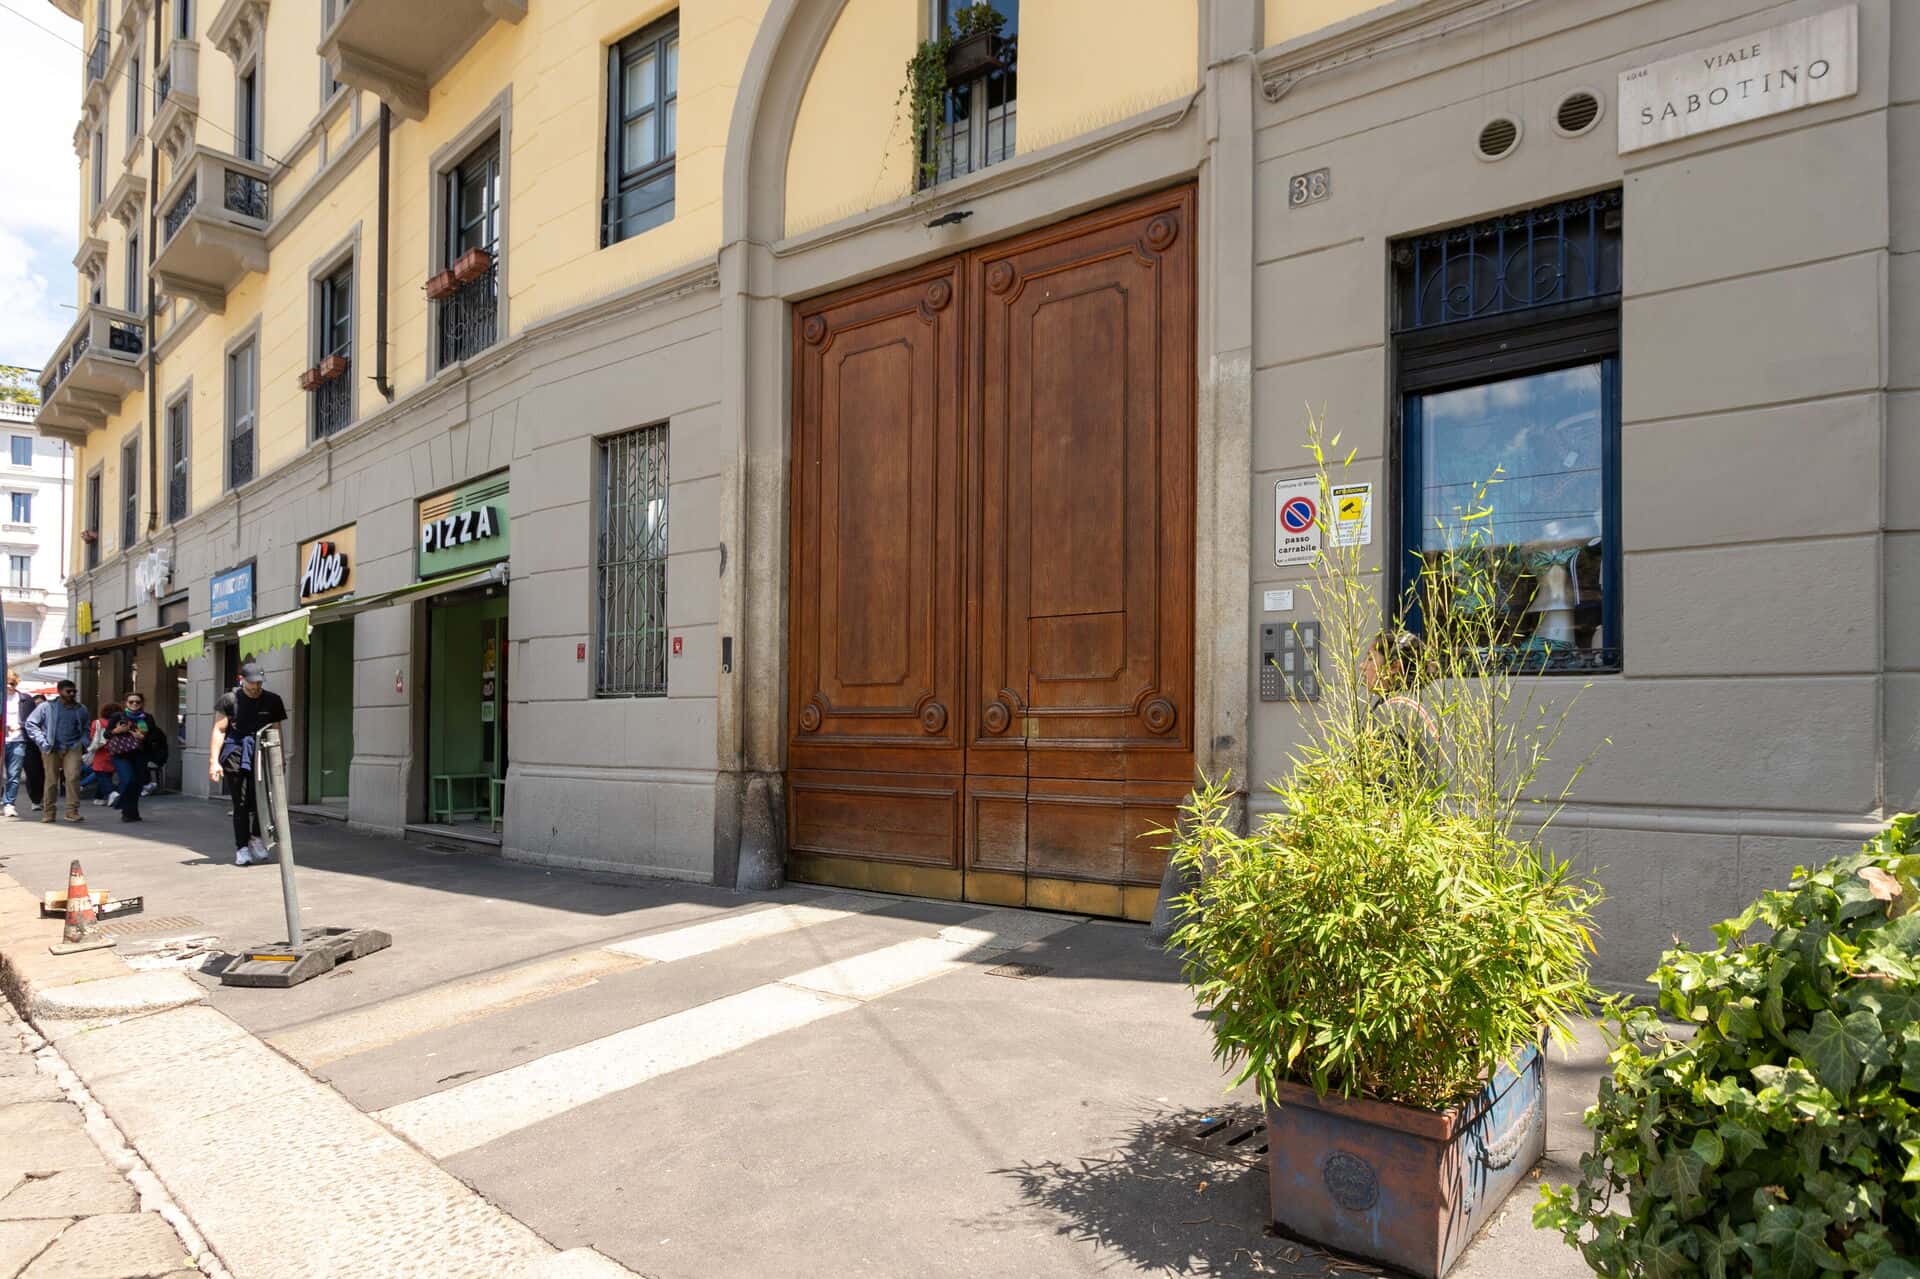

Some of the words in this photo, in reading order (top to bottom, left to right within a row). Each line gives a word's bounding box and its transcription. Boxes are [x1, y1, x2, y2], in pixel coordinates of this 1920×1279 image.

[1703, 43, 1761, 70] VIALE
[1640, 59, 1830, 125] SABOTINO
[422, 504, 496, 553] PIZZA
[1284, 536, 1310, 545] passo
[1278, 544, 1317, 554] carrabile
[300, 542, 346, 598] Alice
